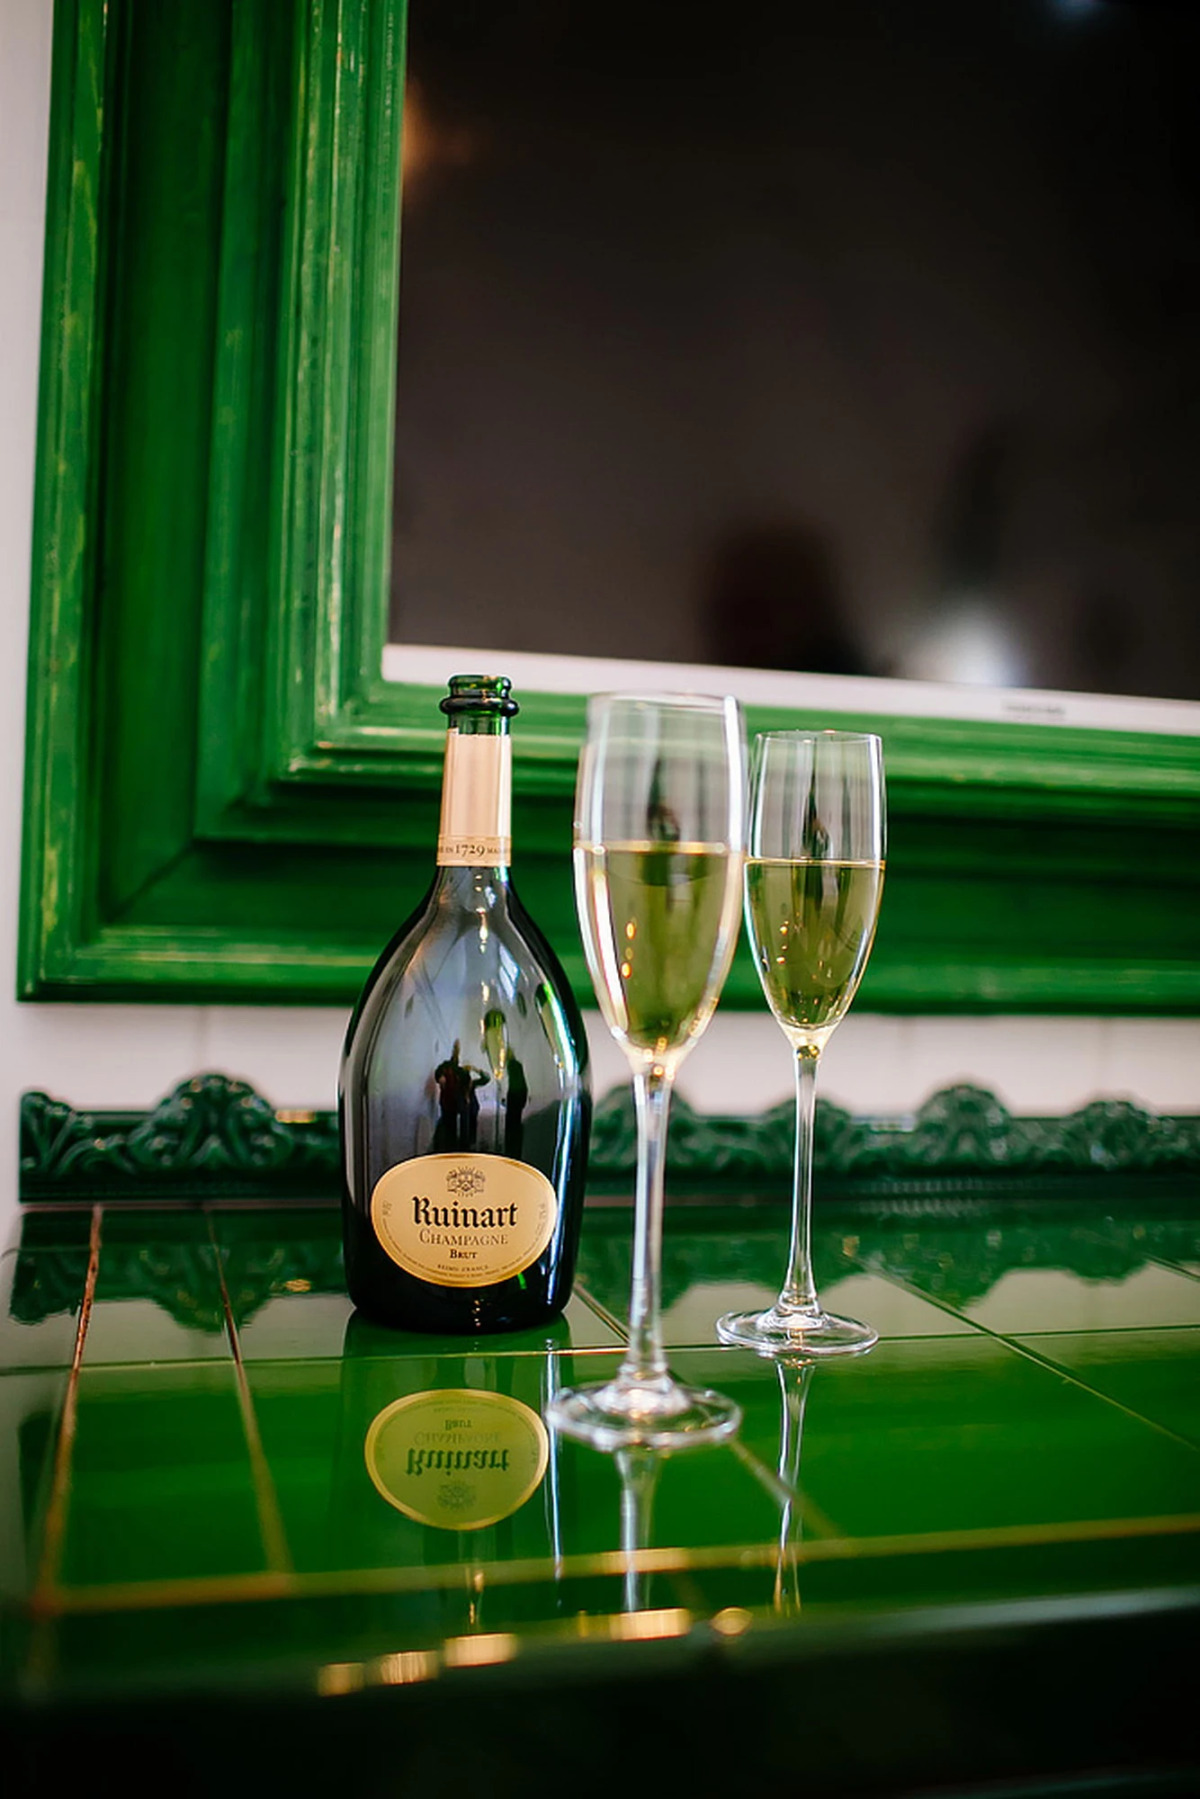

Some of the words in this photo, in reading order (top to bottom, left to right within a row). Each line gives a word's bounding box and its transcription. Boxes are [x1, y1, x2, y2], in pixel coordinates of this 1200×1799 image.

[455, 843, 486, 857] 1729
[411, 1196, 518, 1228] Ruinart
[419, 1228, 509, 1246] CHAMPAGNE
[449, 1249, 478, 1259] BRUT
